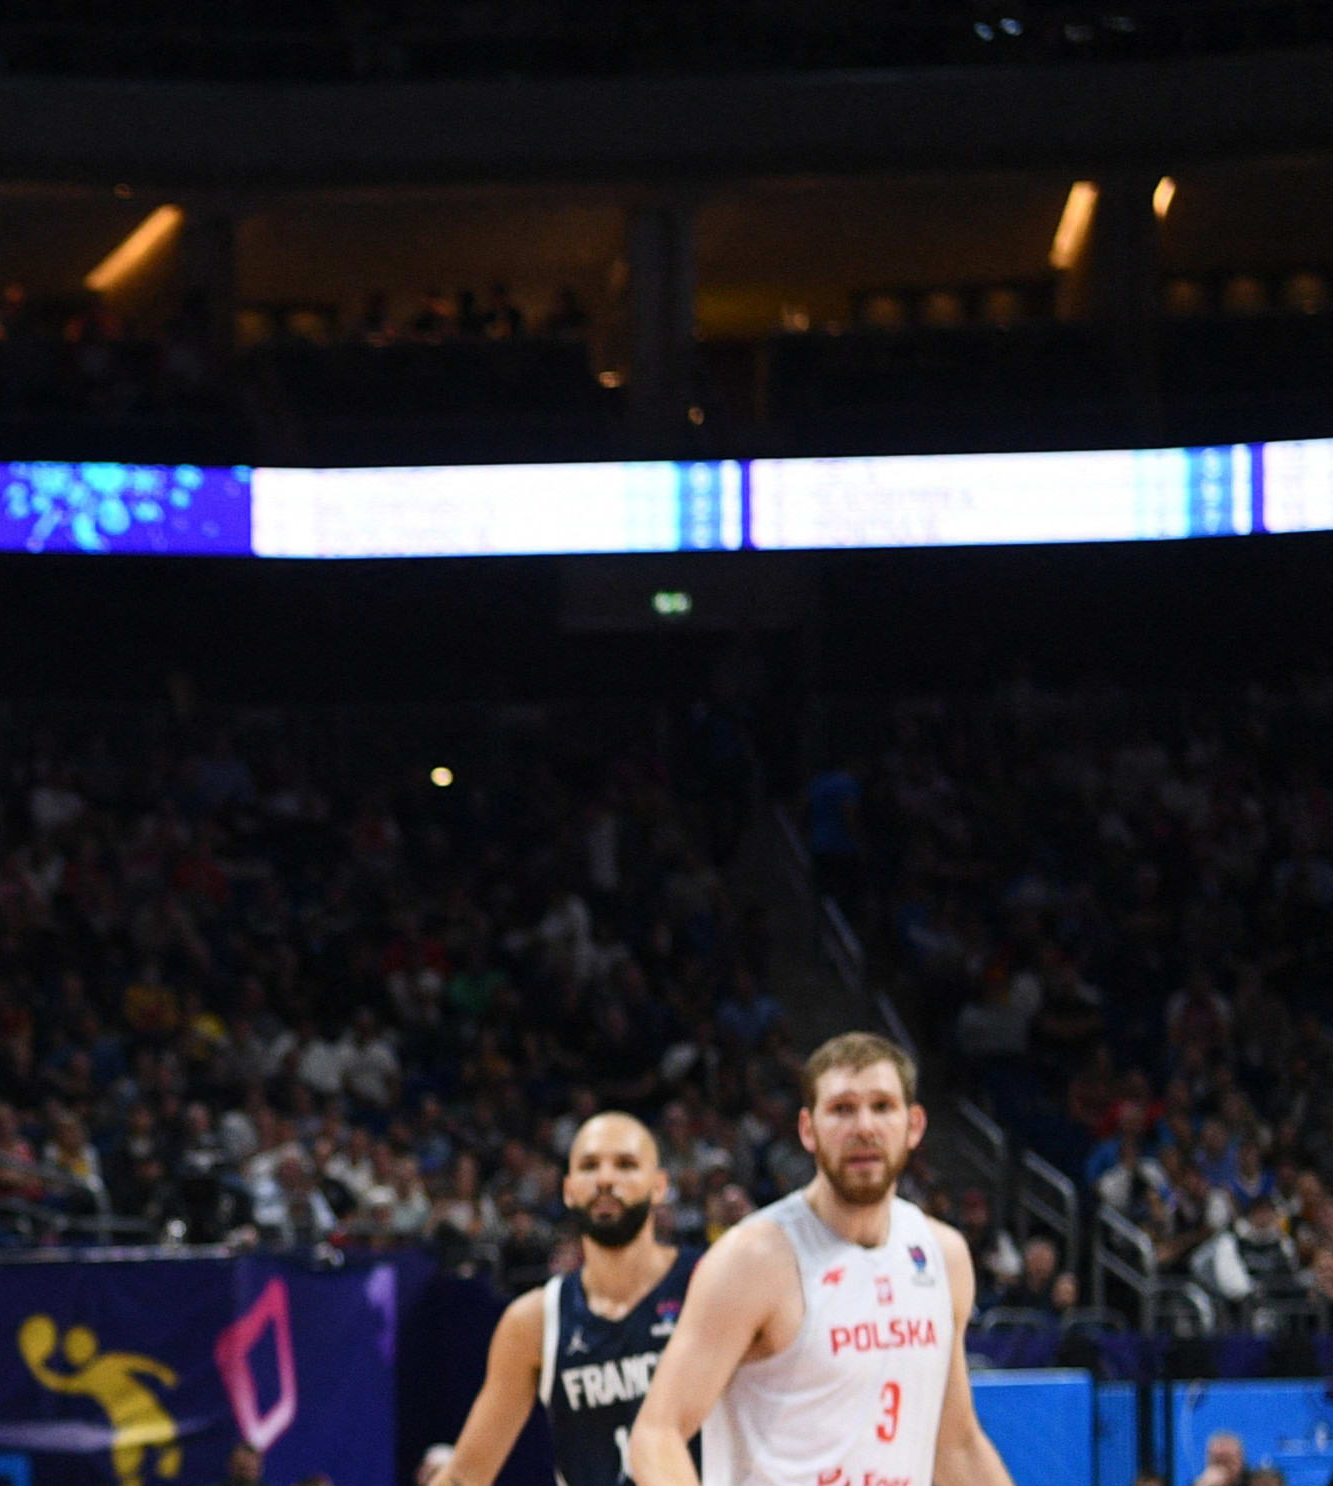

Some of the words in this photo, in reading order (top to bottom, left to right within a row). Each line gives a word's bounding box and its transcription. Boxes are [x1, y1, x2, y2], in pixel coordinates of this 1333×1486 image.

[830, 1318, 937, 1356] POLSKA
[561, 1352, 664, 1411] FRANC
[876, 1380, 901, 1442] 3
